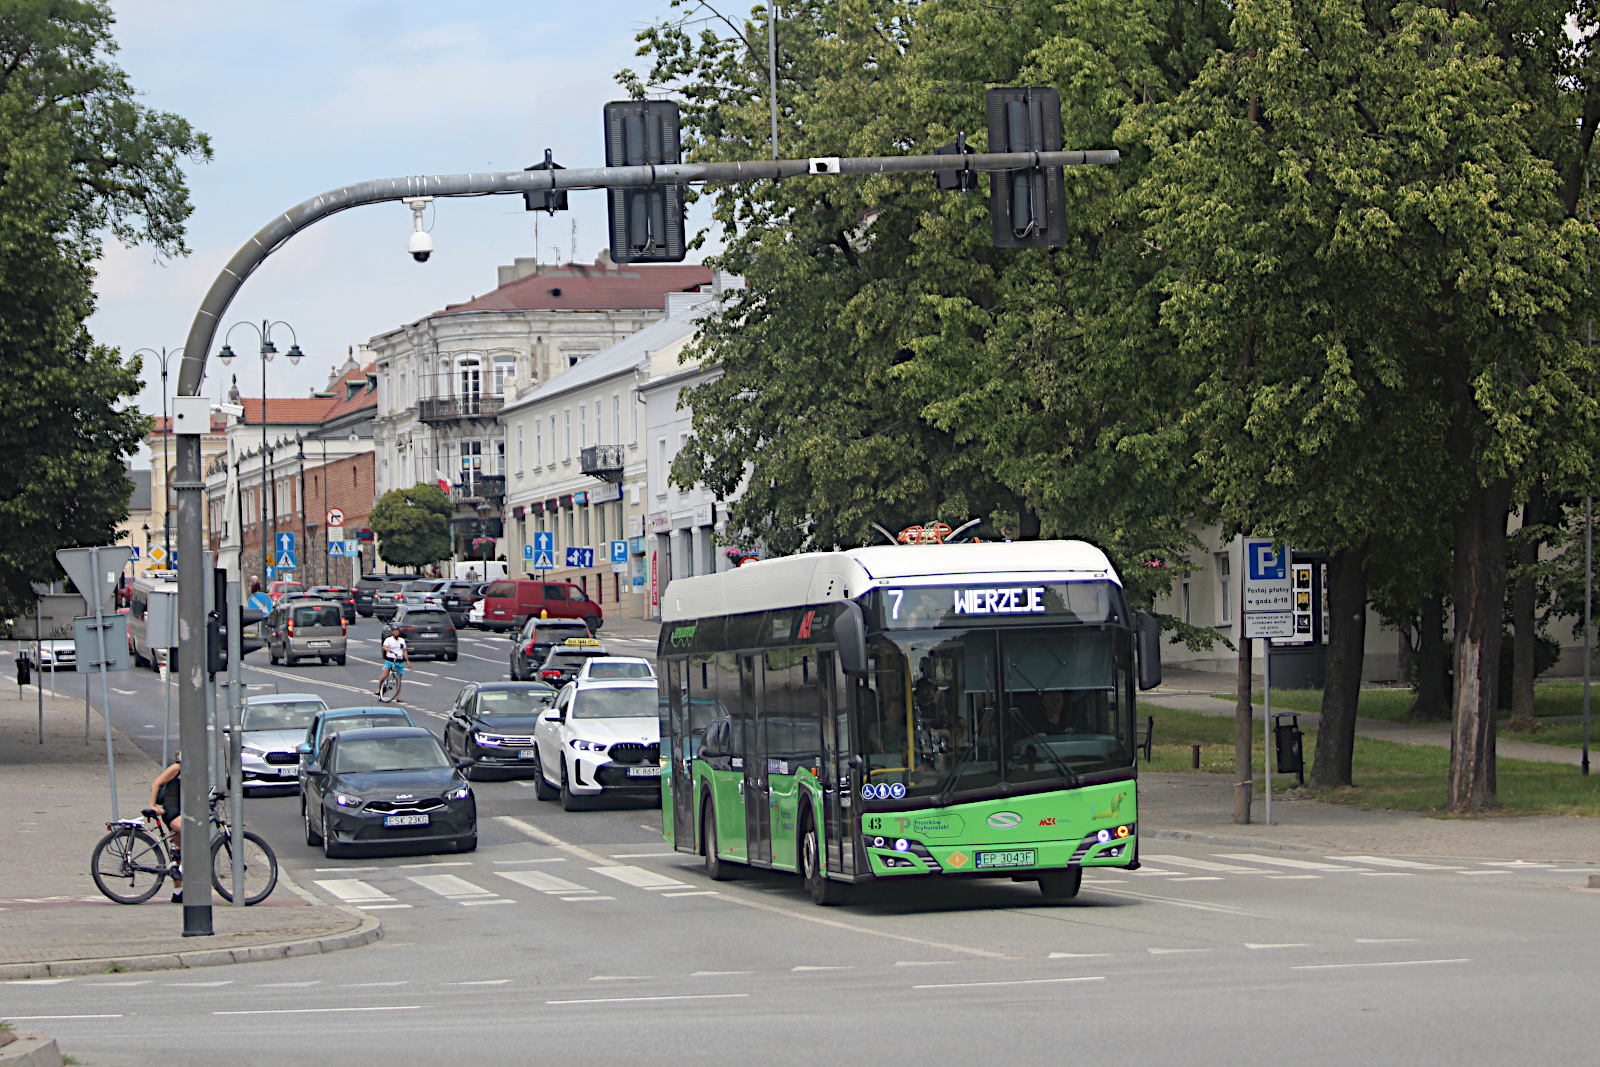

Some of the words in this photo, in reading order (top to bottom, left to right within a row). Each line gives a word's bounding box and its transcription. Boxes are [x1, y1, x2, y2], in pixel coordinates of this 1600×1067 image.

[614, 543, 624, 556] P
[1257, 547, 1278, 575] P
[887, 589, 904, 620] 7
[953, 587, 1045, 614] WIERZEJE
[388, 816, 405, 825] ESK
[408, 815, 428, 824] 23KG
[868, 817, 882, 830] 43
[983, 853, 997, 864] EP
[1000, 851, 1032, 863] 3043F
